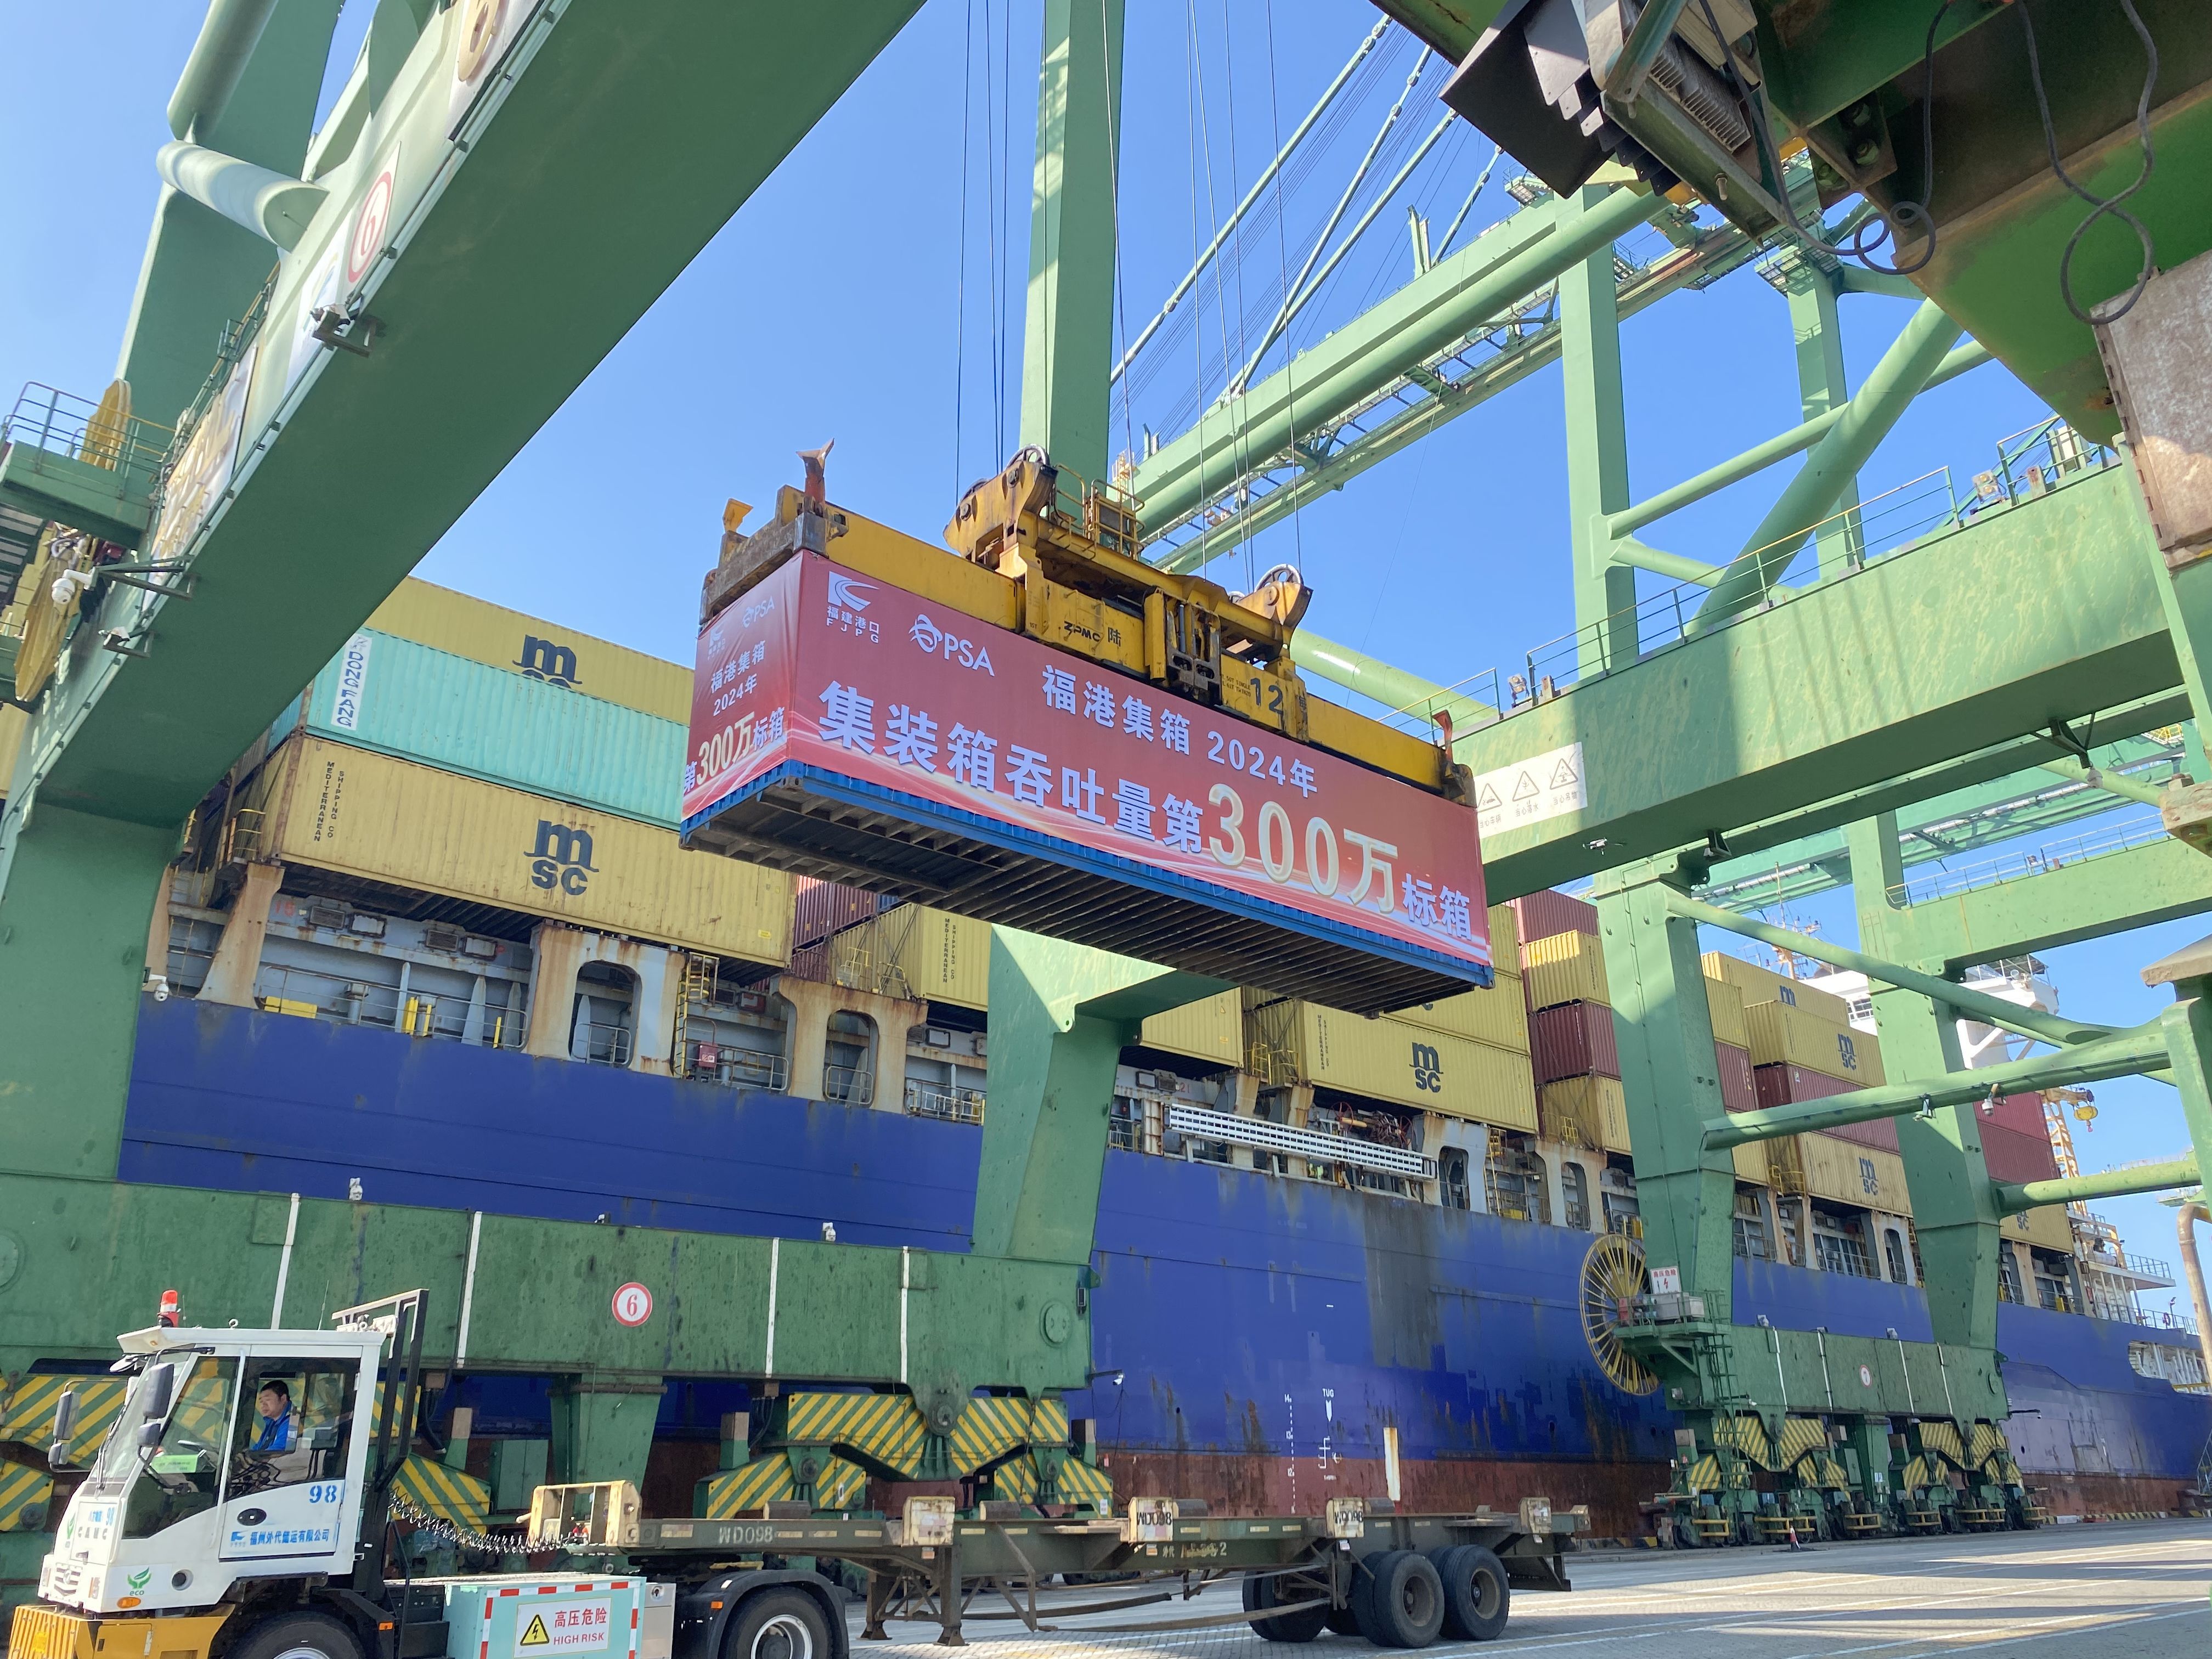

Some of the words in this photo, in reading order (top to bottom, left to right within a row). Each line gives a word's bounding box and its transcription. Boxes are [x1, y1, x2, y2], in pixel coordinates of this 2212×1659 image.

[753, 595, 775, 623] PSA
[827, 606, 880, 634] 福建港口
[1064, 620, 1101, 642] ZPMC
[1108, 627, 1122, 647] 陆
[343, 651, 364, 689] DONG
[710, 640, 766, 694] 福港集箱
[944, 632, 995, 677] PSA
[336, 689, 358, 727] FANG
[713, 673, 757, 716] 2024年
[1250, 677, 1284, 715] 12
[1042, 664, 1190, 756] 福港集箱
[1207, 730, 1317, 798] 2024年
[684, 707, 785, 794] 第300万标箱
[314, 761, 335, 842] MEDITERRANEAN
[331, 771, 345, 820] SHIPPING
[819, 680, 1472, 941] 集装箱吞吐量第300万标箱
[327, 826, 334, 838] CO
[627, 1294, 637, 1316] 6
[1322, 1389, 1334, 1398] TUG
[309, 1485, 337, 1504] 98
[719, 1526, 773, 1544] WD098
[554, 1607, 607, 1628] 高压危险
[554, 1635, 579, 1645] HIGH
[582, 1632, 605, 1643] RISK
